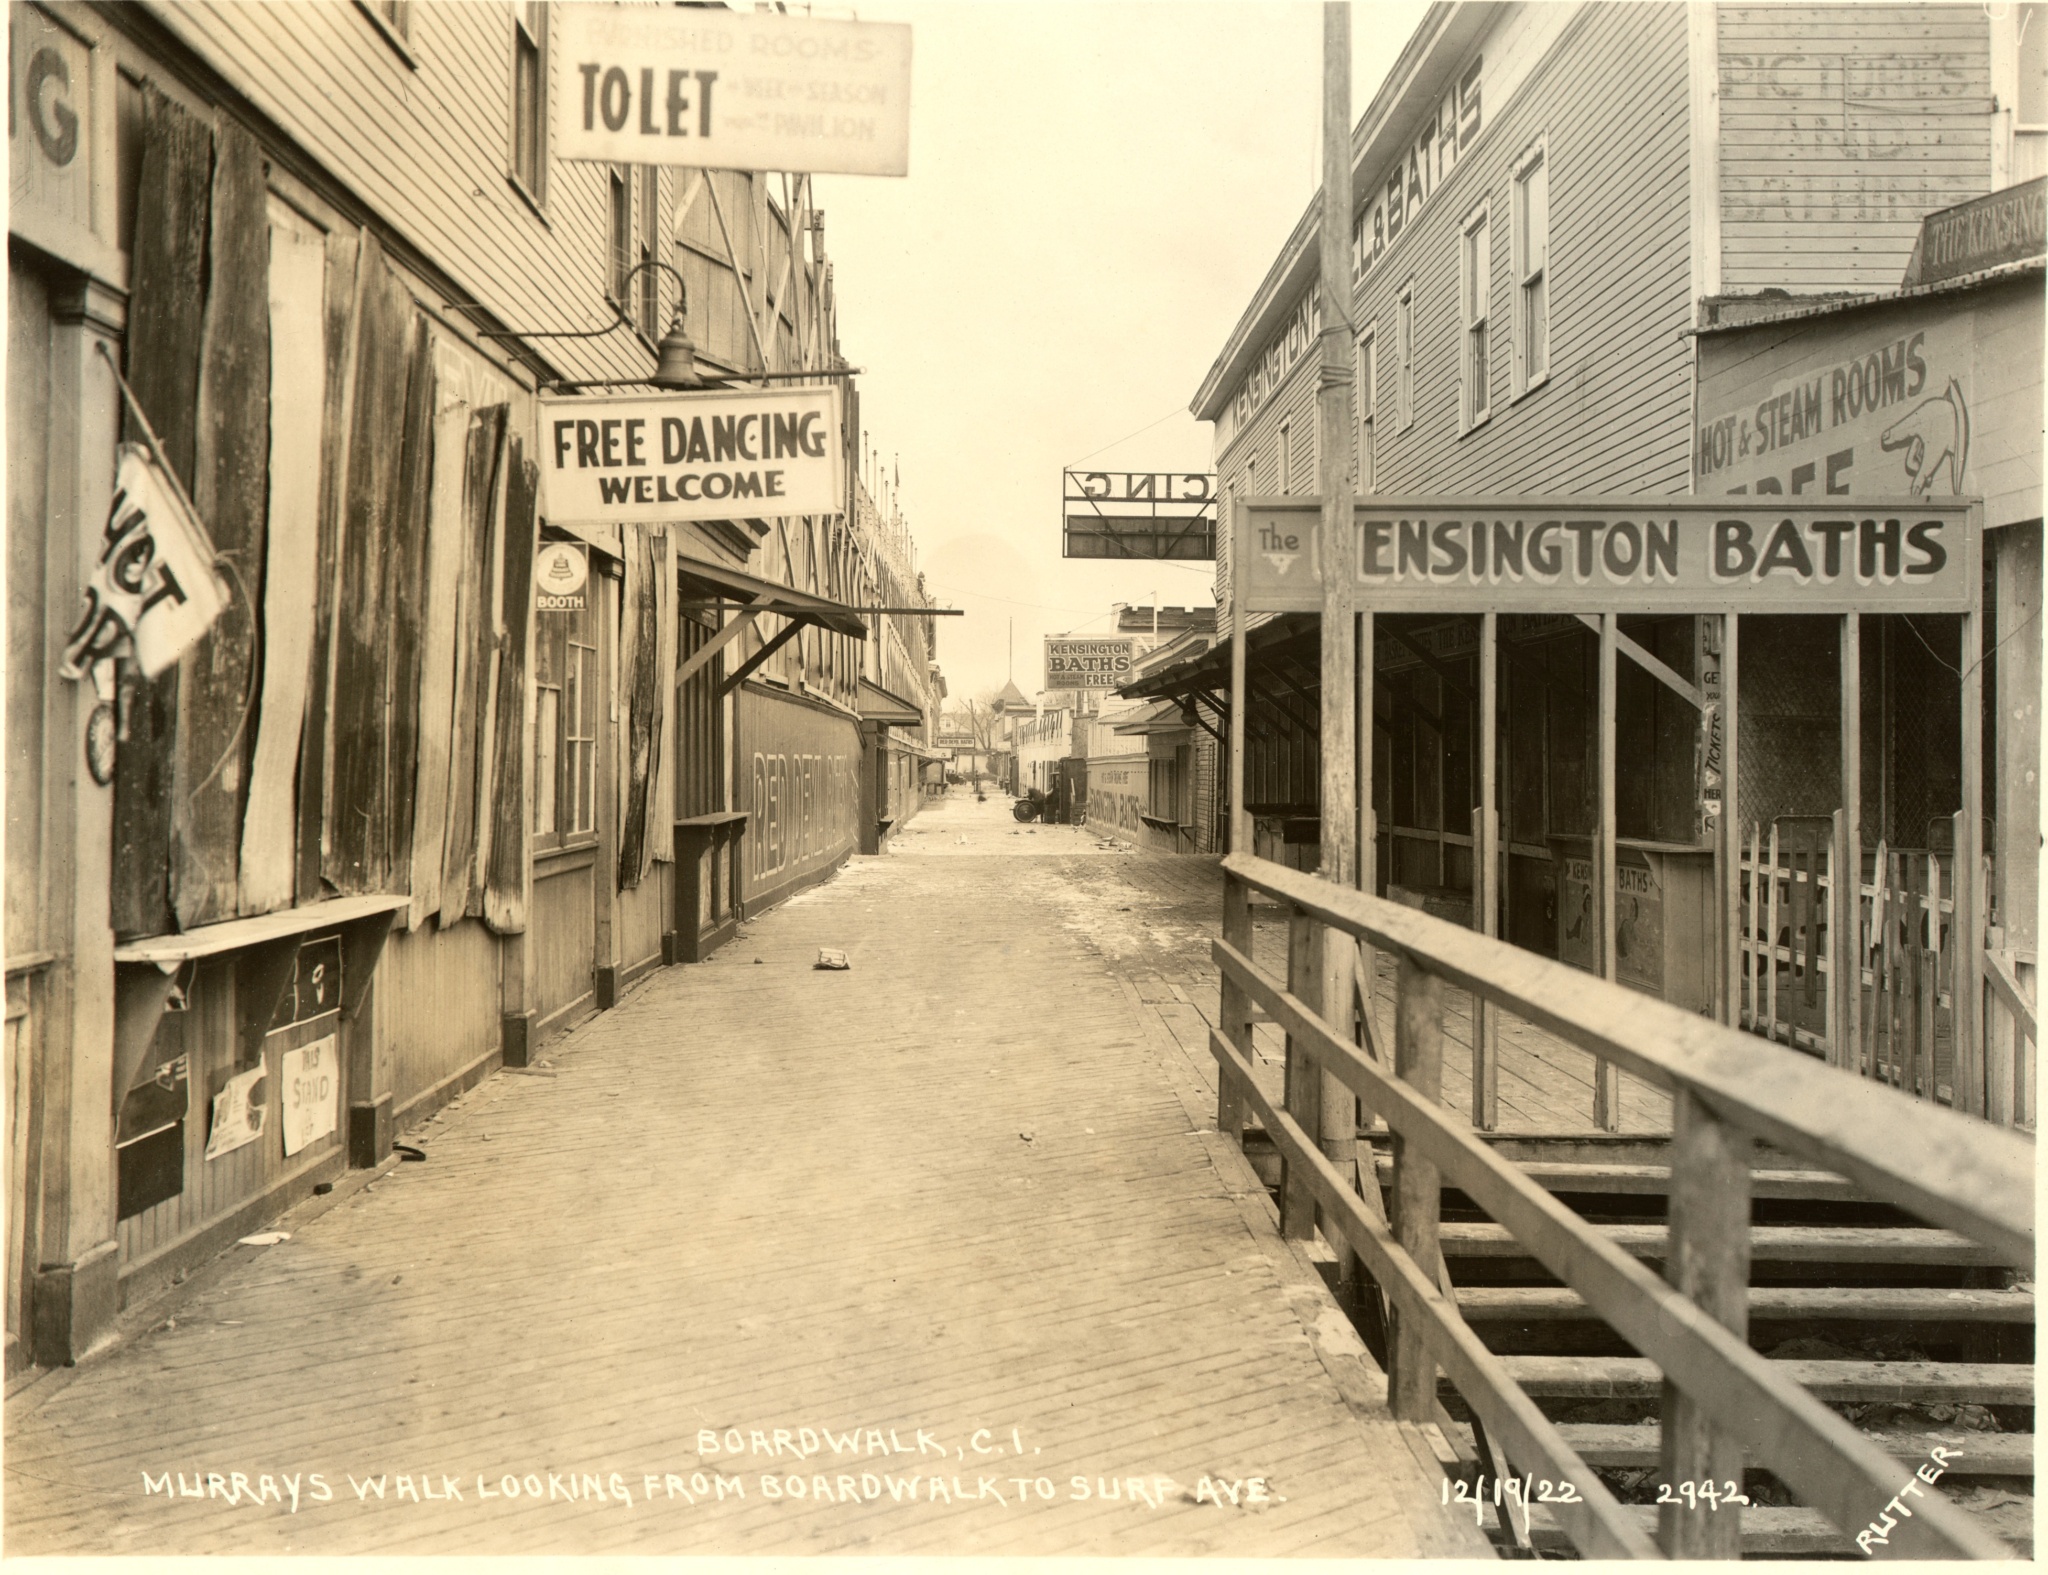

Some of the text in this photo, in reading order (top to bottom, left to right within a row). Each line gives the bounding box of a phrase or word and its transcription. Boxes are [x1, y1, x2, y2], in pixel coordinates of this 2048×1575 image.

[578, 63, 718, 137] TO LET
[1931, 189, 2047, 267] THE KENSING
[1232, 289, 1310, 439] KENSINGTON
[1387, 53, 1483, 245] BATHS
[1701, 415, 1736, 476] HOT
[1738, 419, 1752, 458] &
[1755, 378, 1823, 457] STEAM
[1832, 331, 1928, 428] ROOMS
[554, 411, 826, 469] FREE DANCING
[599, 470, 786, 505] WELCOME
[1258, 518, 1948, 586] The ENSINGTON BATHS
[537, 595, 585, 609] BOOTH
[1048, 643, 1129, 656] KENSINGTON
[1049, 655, 1131, 673] BATHS
[1085, 673, 1115, 686] FREE
[1703, 671, 1721, 685] GE
[1705, 712, 1721, 776] TICKETS
[1704, 788, 1721, 800] HER
[753, 751, 788, 882] RED
[1618, 868, 1649, 894] BATHS
[293, 1075, 329, 1110] STAND
